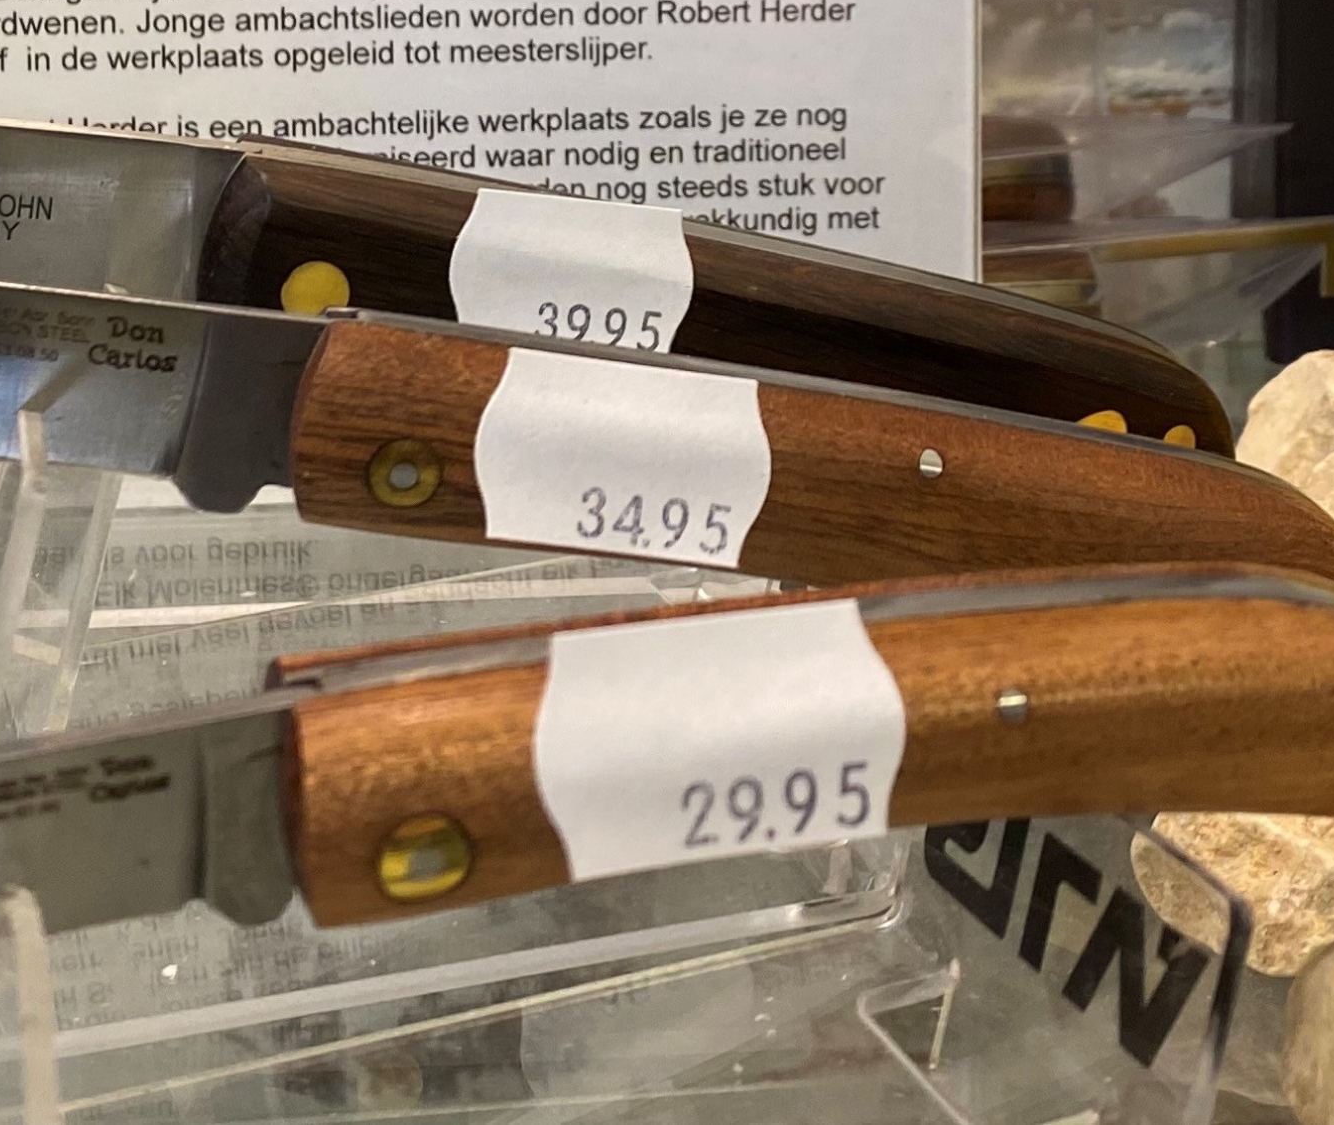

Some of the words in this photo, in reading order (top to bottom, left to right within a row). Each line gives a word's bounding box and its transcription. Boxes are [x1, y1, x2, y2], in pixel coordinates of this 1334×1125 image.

[137, 8, 225, 38] Jonge
[235, 6, 460, 31] ambachtslieden
[470, 2, 573, 28] worden
[584, 1, 648, 25] door
[657, 0, 750, 24] Robert
[27, 46, 50, 72] in
[62, 45, 97, 71] de
[107, 43, 263, 75] werkplaats
[274, 40, 394, 73] opgeleid
[404, 41, 440, 64] tot
[450, 37, 652, 67] meesterslijper.
[177, 115, 199, 137] is
[209, 120, 262, 138] een
[273, 110, 469, 140] ambachtelijke
[478, 107, 629, 137] werkplaats
[639, 105, 711, 129] zoals
[719, 104, 745, 134] je
[754, 109, 787, 127] ze
[797, 108, 846, 132] nog
[485, 148, 555, 168] waar
[564, 141, 639, 169] nodig
[650, 146, 683, 164] en
[693, 137, 845, 164] traditioneel
[597, 182, 646, 204] nog
[657, 175, 748, 199] steeds
[758, 174, 815, 197] stuk
[824, 177, 886, 195] voor
[828, 207, 881, 230] met
[107, 316, 164, 344] Don
[534, 302, 662, 352] 3995
[88, 343, 178, 372] Carlos
[577, 487, 733, 555] 34.95
[681, 761, 872, 849] 29.95
